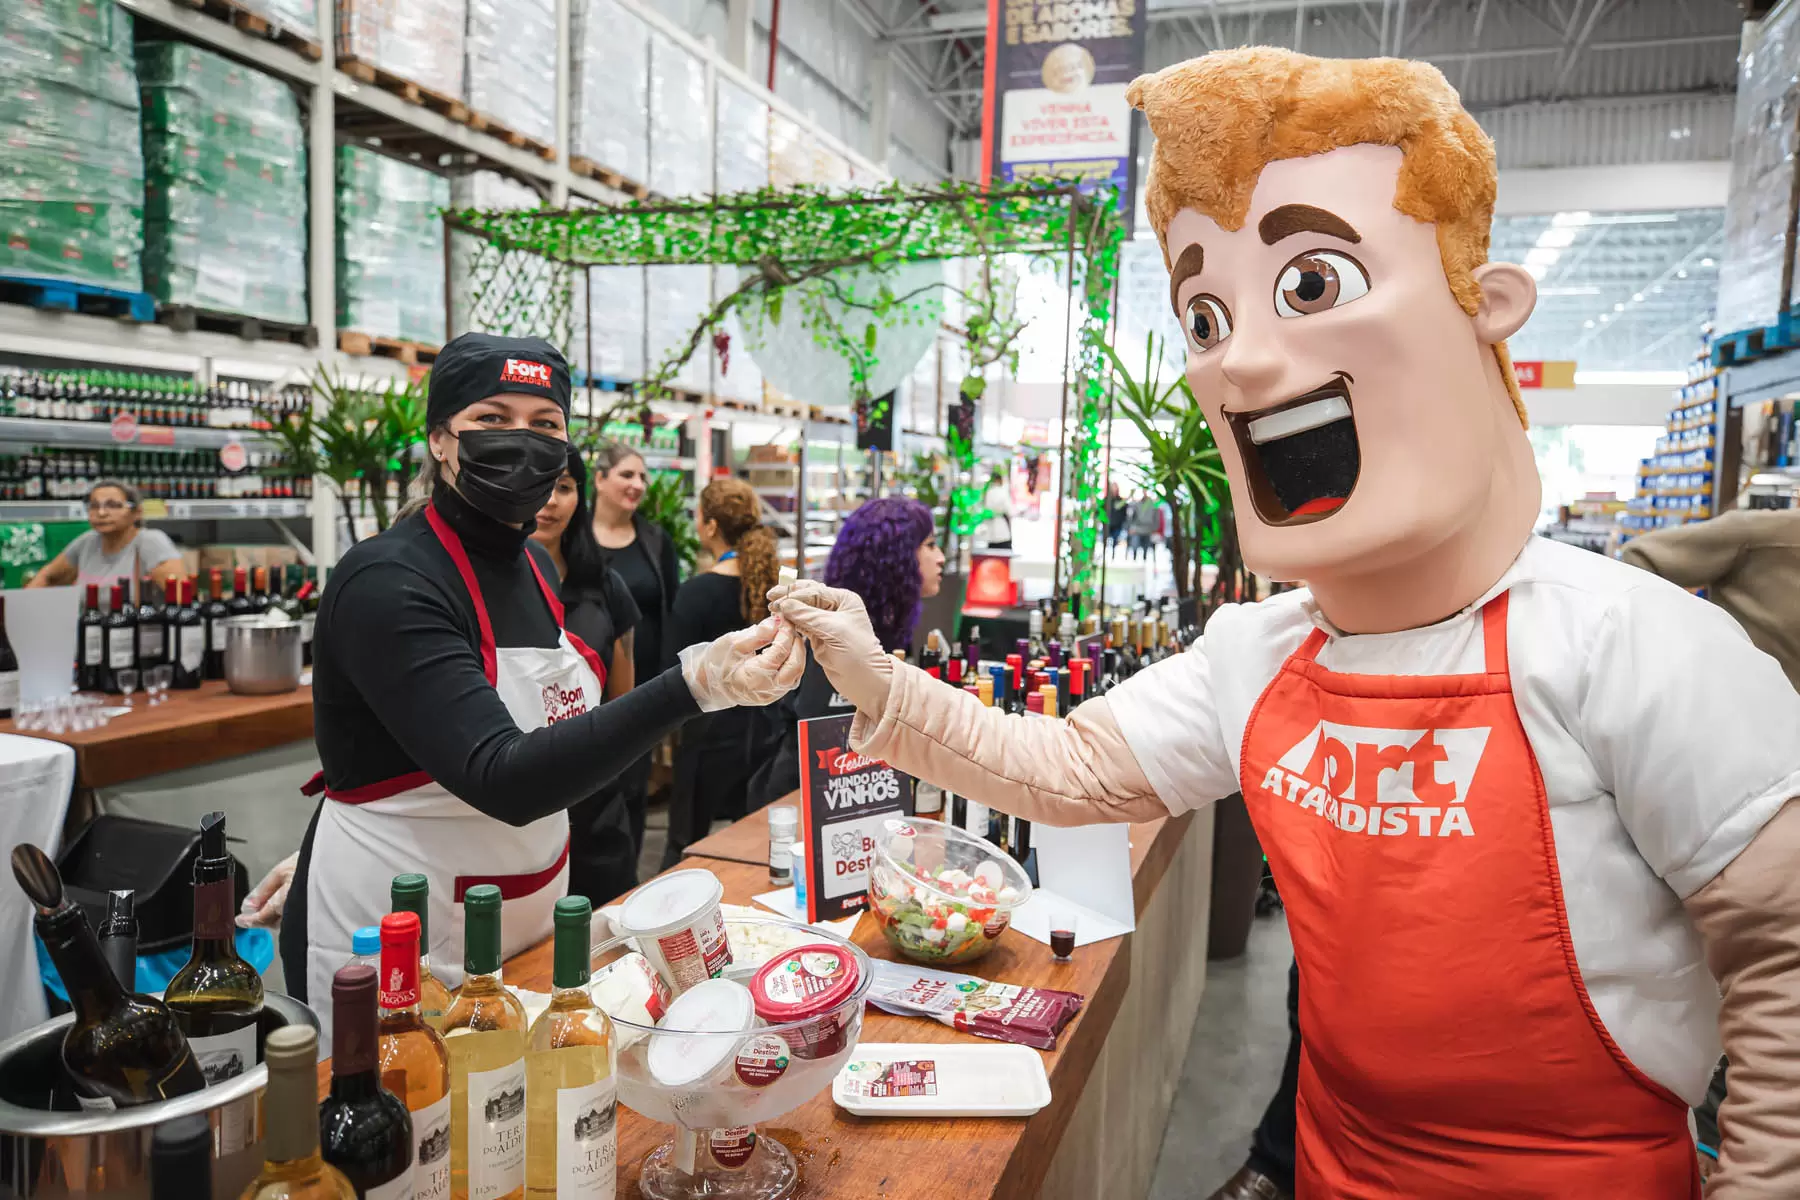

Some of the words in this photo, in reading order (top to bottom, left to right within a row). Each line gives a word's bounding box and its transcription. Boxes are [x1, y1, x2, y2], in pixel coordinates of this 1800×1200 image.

[499, 372, 553, 389] ATACADISTA
[507, 358, 549, 381] Fort
[560, 686, 585, 706] Bom
[828, 773, 870, 791] MUNDO
[871, 769, 895, 784] DOS
[823, 779, 900, 811] VINHOS
[1260, 766, 1475, 837] ATACADISTA
[753, 1048, 779, 1056] Destino
